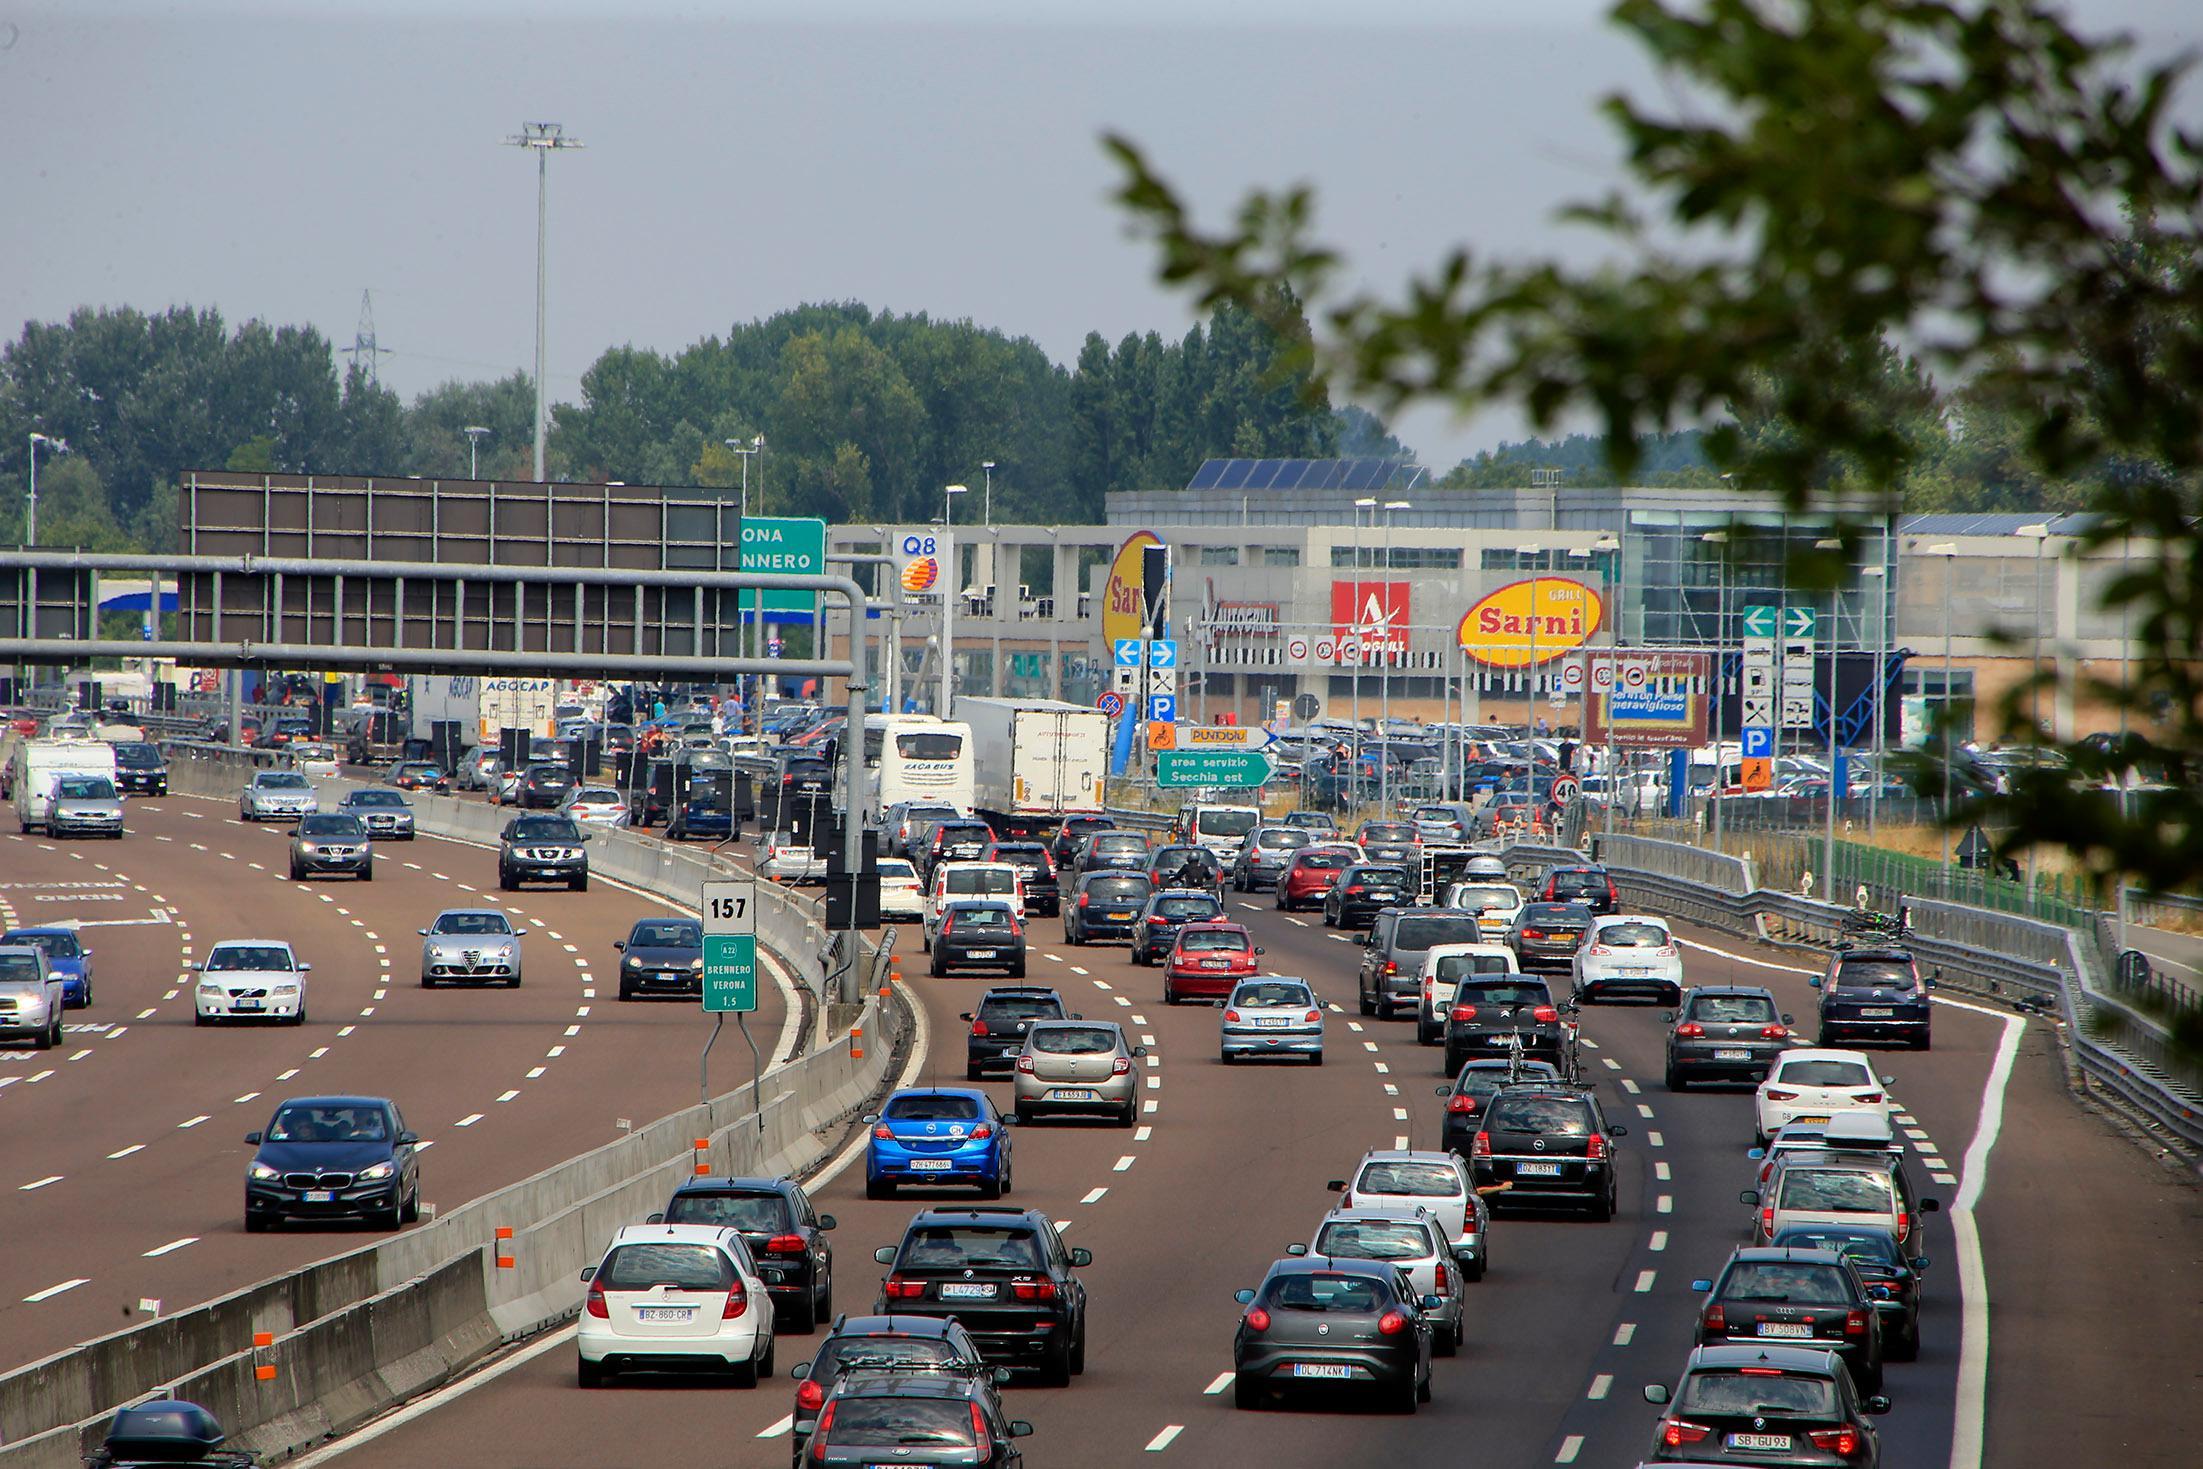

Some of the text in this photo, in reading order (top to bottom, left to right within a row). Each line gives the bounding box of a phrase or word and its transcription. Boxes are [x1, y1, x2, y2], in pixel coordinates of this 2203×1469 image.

[903, 536, 936, 556] Q8
[1549, 589, 1582, 600] GRILL
[1480, 607, 1582, 636] Sarni
[486, 680, 549, 692] AGOCAP
[1154, 697, 1171, 721] P
[1747, 730, 1767, 754] P
[1170, 757, 1248, 767] area servizio
[1171, 772, 1243, 782] Secchia est
[1556, 784, 1577, 798] 40
[711, 898, 746, 919] 157
[707, 965, 751, 975] BRENNERO
[713, 980, 746, 990] VERONA
[1301, 1364, 1344, 1376] DL 714NK
[1738, 1434, 1787, 1448] SB GU 93
